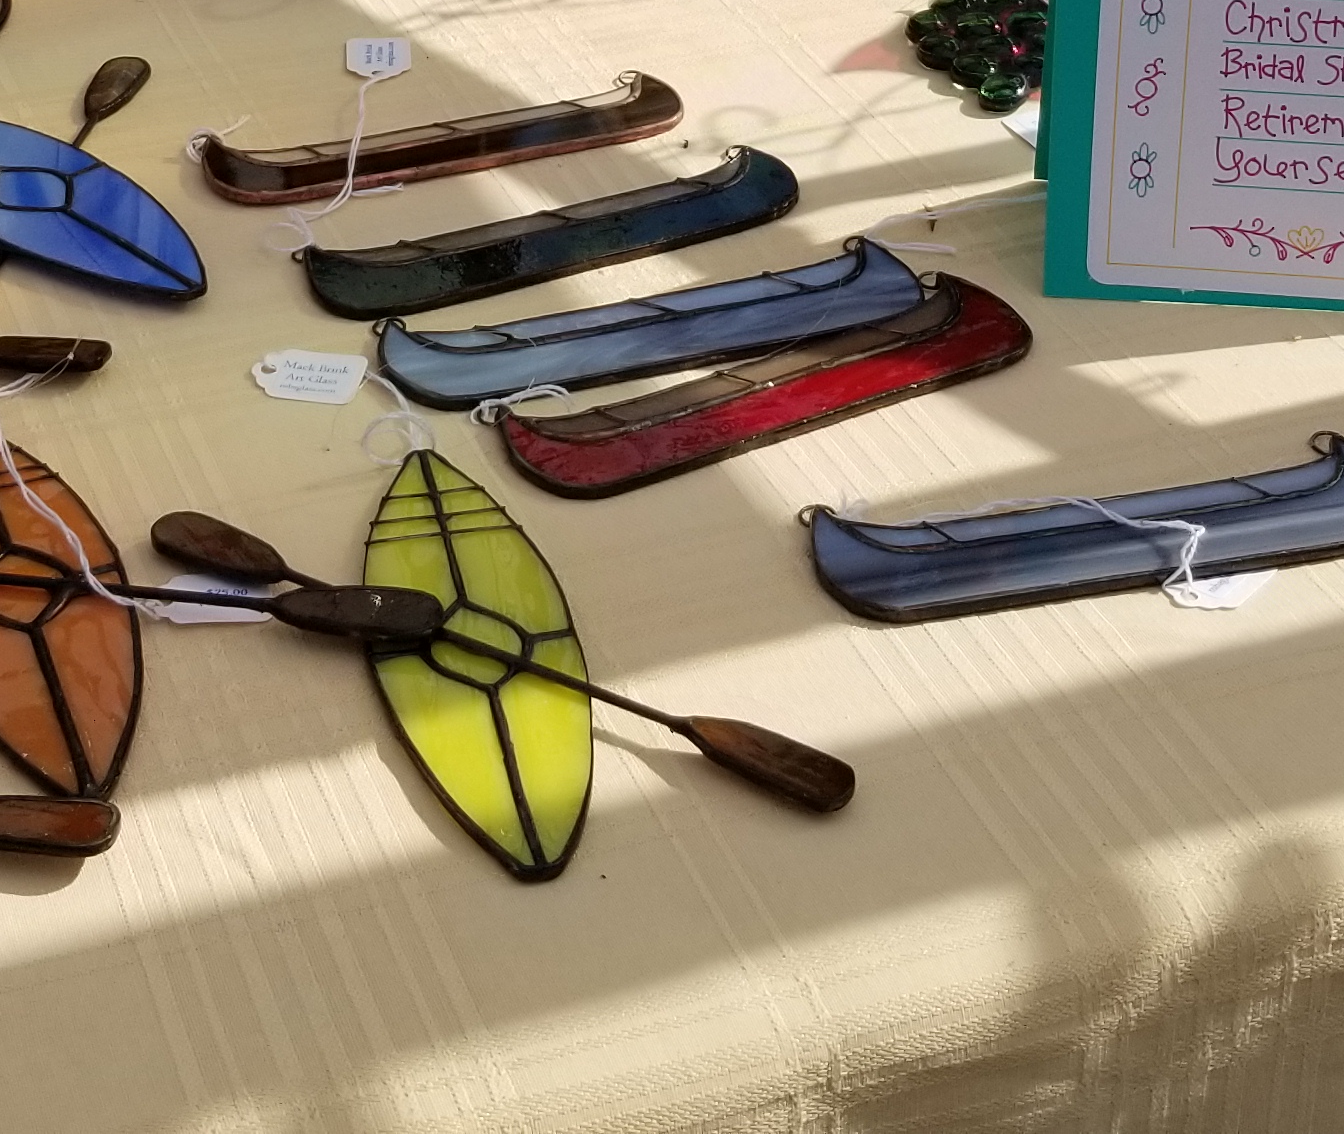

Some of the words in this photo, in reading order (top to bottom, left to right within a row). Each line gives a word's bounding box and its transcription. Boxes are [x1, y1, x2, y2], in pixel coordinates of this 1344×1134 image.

[1220, 47, 1306, 85] Bridal
[283, 360, 315, 372] Mack
[286, 372, 304, 382] Art
